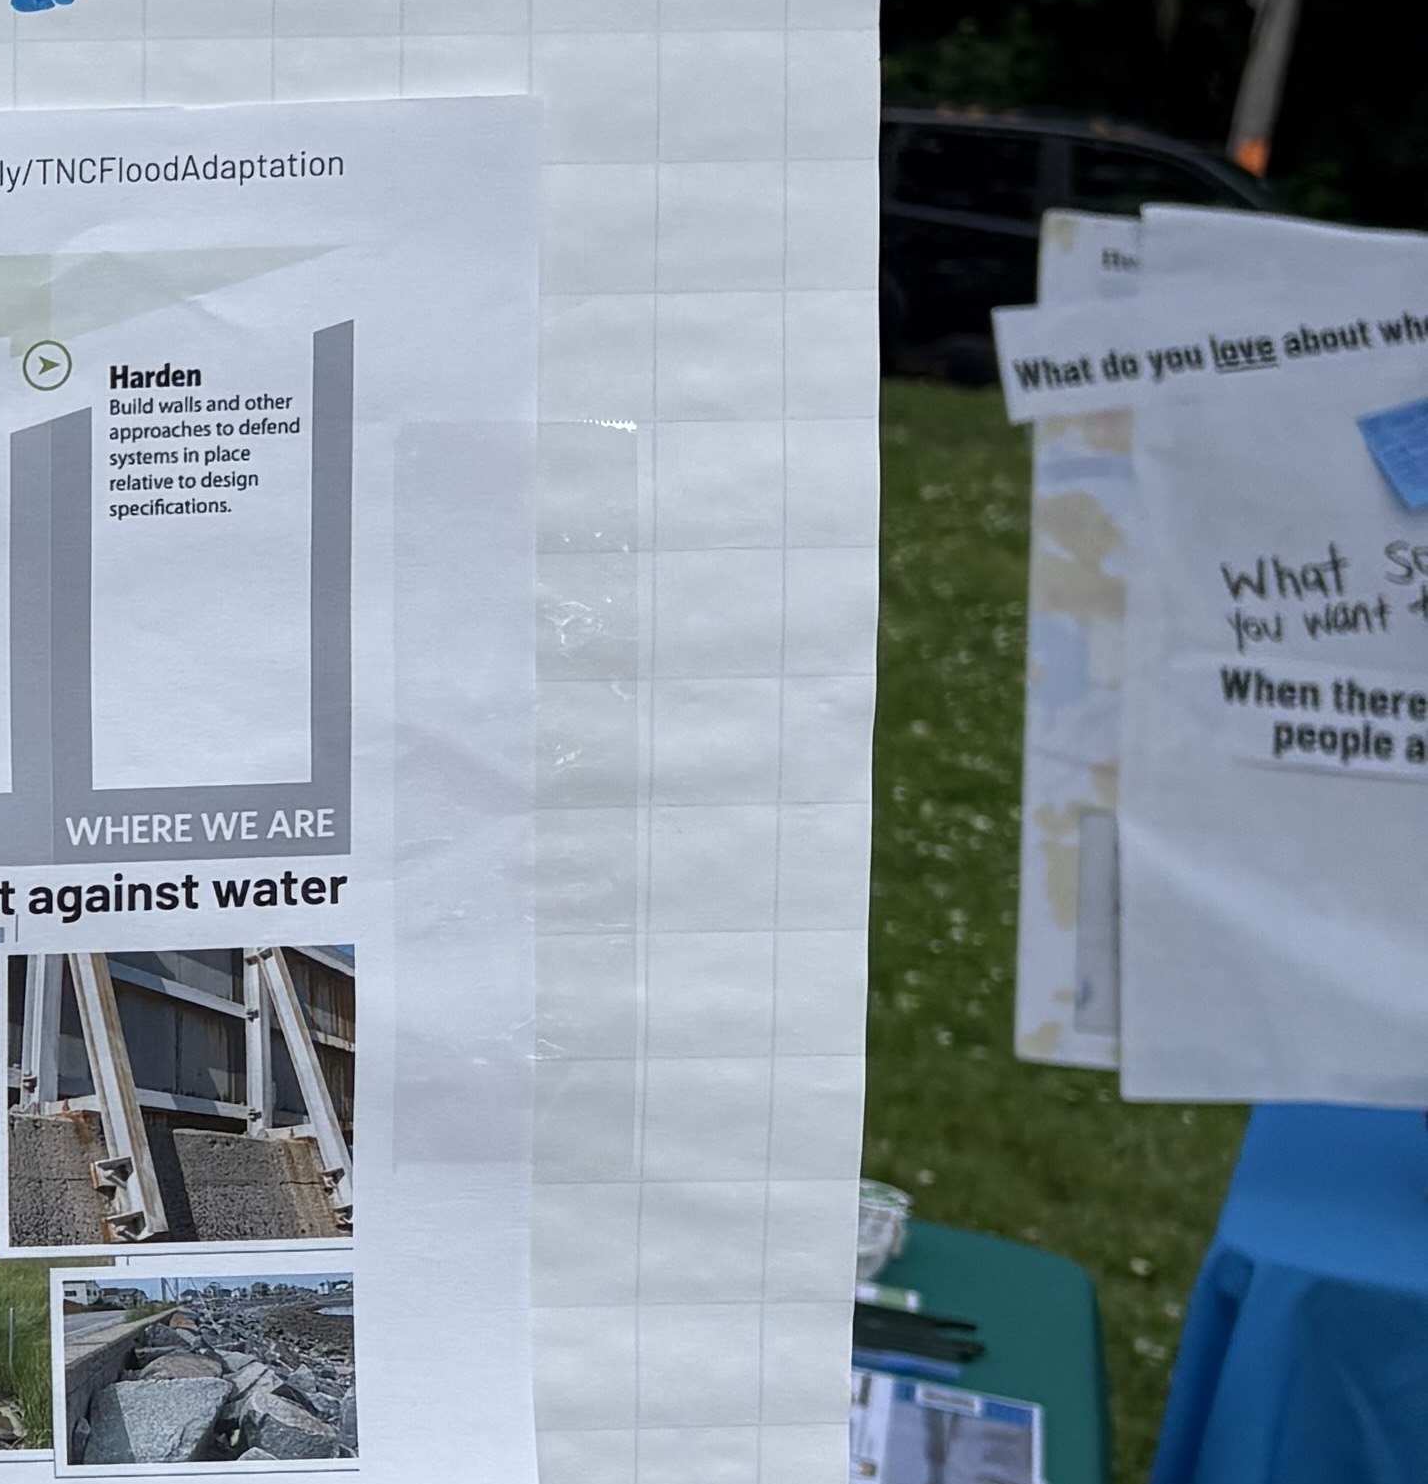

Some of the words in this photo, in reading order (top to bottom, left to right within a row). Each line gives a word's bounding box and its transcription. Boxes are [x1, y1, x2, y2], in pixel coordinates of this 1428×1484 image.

[1014, 354, 1096, 392] What
[1100, 348, 1141, 383] do
[1147, 343, 1204, 386] you
[1209, 333, 1280, 374] love
[1282, 323, 1371, 361] about
[1377, 310, 1428, 347] wh
[108, 361, 203, 391] Harden
[108, 396, 155, 417] Build
[157, 394, 204, 415] walls
[204, 393, 241, 414] and
[243, 392, 294, 412] other
[108, 419, 213, 445] approaches
[214, 421, 236, 438] to
[237, 415, 302, 437] defend
[108, 449, 180, 471] systems
[182, 445, 201, 465] in
[203, 443, 252, 468] place
[108, 472, 175, 493] relative
[176, 473, 198, 491] to
[199, 469, 260, 493] design
[107, 496, 233, 522] specifications.
[1218, 538, 1350, 601] What
[1226, 606, 1284, 655] you
[1303, 594, 1392, 641] want
[1220, 665, 1322, 713] When
[1271, 720, 1394, 766] people
[63, 812, 194, 847] WHERE
[199, 809, 260, 843] WE
[264, 806, 337, 841] ARE
[26, 872, 200, 925] against
[210, 869, 349, 910] water
